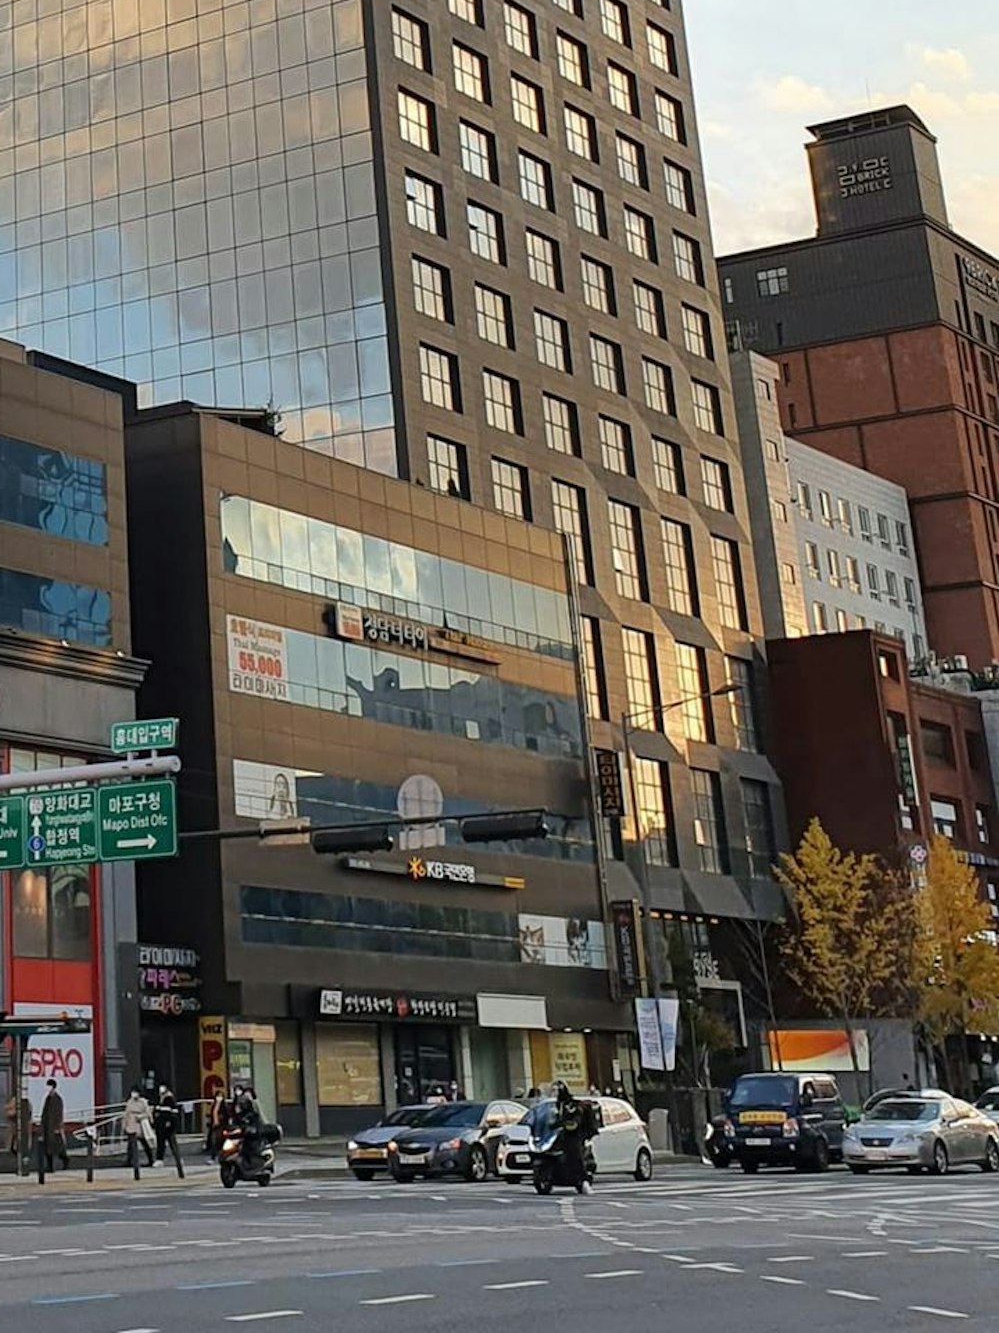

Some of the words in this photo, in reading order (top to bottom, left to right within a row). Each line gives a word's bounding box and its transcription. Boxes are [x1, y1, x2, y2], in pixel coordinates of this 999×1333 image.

[239, 651, 282, 678] 55,000
[115, 723, 173, 746] 홍대입구역
[108, 791, 161, 814] 마포구청
[103, 817, 129, 832] Mapo
[131, 815, 149, 829] Dist
[29, 1048, 84, 1078] SPAO
